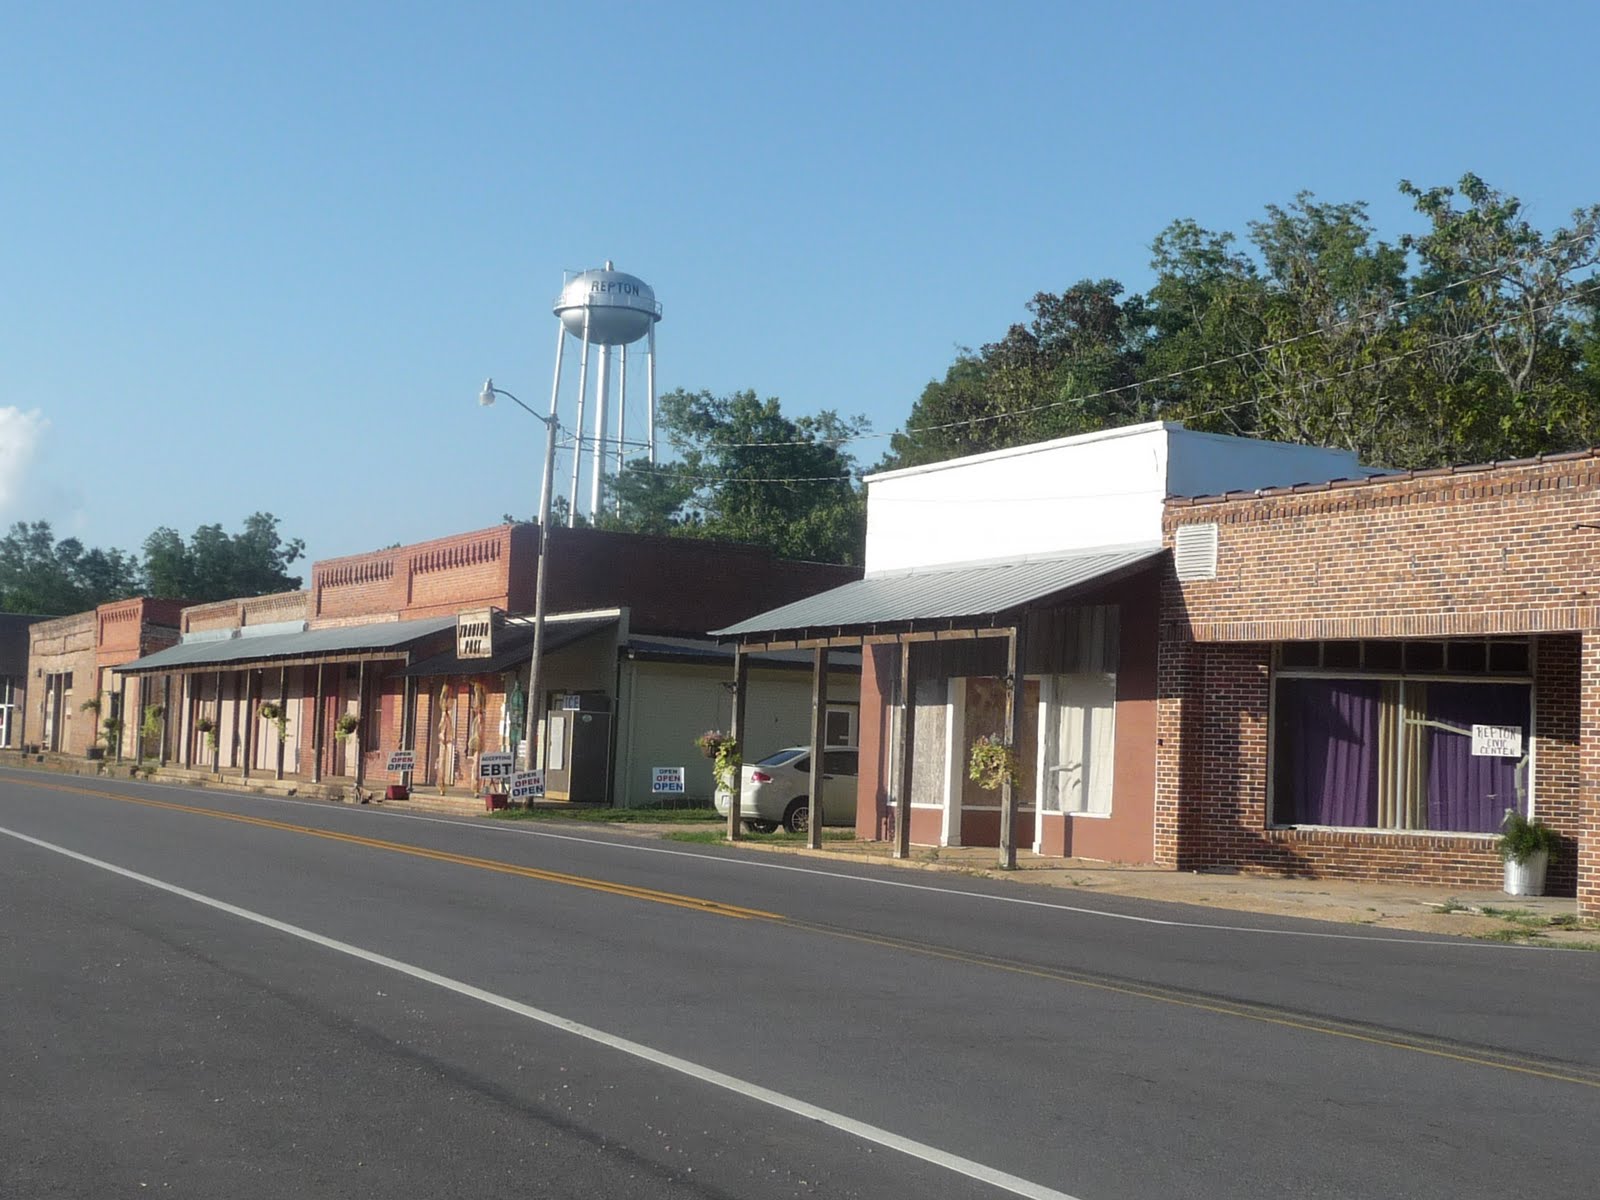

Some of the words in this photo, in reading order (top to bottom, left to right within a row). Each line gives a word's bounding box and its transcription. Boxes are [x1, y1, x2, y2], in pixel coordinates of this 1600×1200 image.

[591, 280, 640, 296] REPTON
[1476, 726, 1516, 740] REPTON
[481, 763, 512, 776] EBT
[517, 772, 537, 780] OPEN
[514, 777, 540, 788] OPEN
[653, 782, 684, 791] OPEN
[512, 785, 544, 797] OPEN
